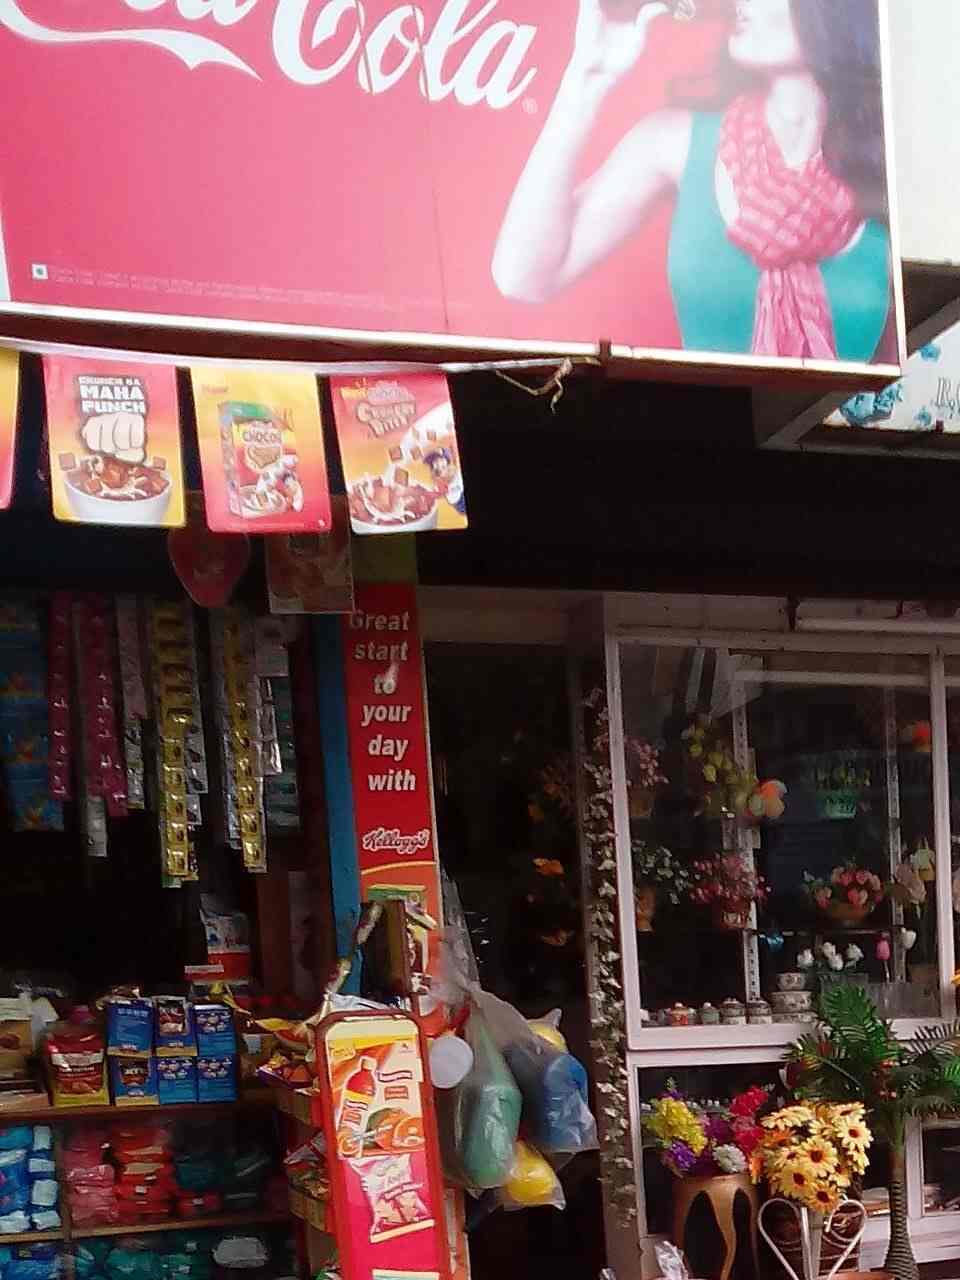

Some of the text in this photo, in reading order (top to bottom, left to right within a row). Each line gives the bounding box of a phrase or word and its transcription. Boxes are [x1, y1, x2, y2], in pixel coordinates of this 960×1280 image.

[80, 384, 144, 400] MAHA
[82, 400, 146, 414] PUNCH
[350, 610, 409, 631] Great
[354, 641, 408, 661] start
[374, 673, 396, 694] to
[361, 703, 411, 726] your
[368, 734, 408, 761] day
[368, 769, 416, 791] with
